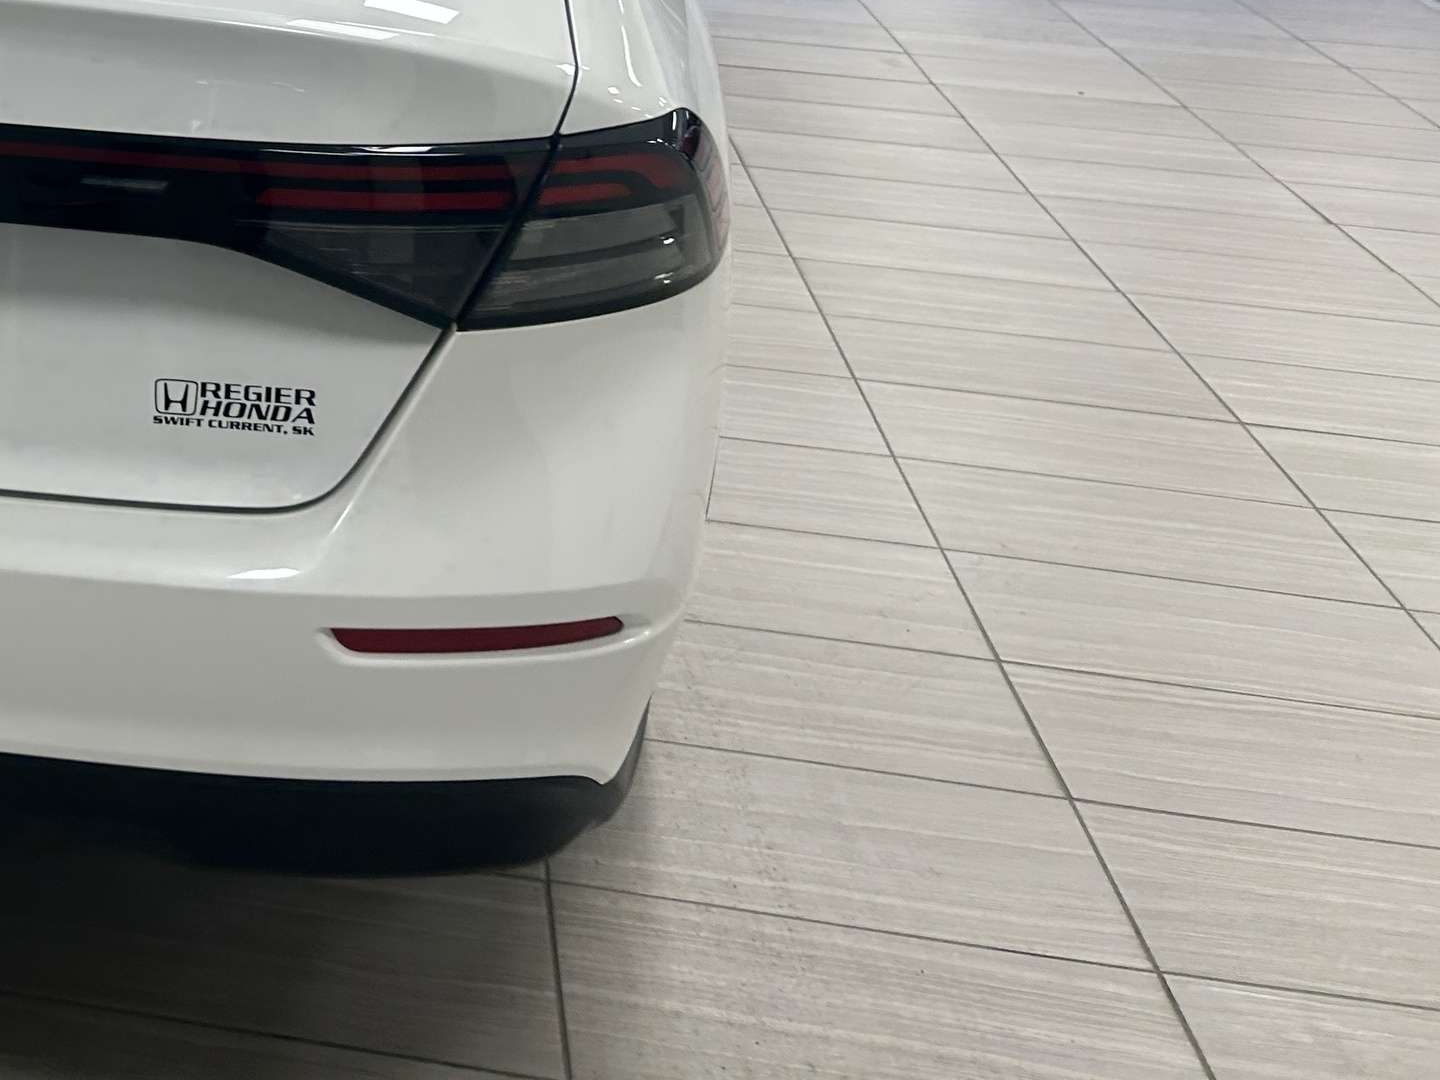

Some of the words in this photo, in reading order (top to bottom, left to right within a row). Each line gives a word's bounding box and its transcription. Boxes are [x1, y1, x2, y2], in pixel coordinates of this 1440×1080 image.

[200, 381, 317, 407] REGIER
[199, 399, 316, 425] HONDA
[153, 415, 206, 428] SWIFT
[292, 426, 316, 437] SK
